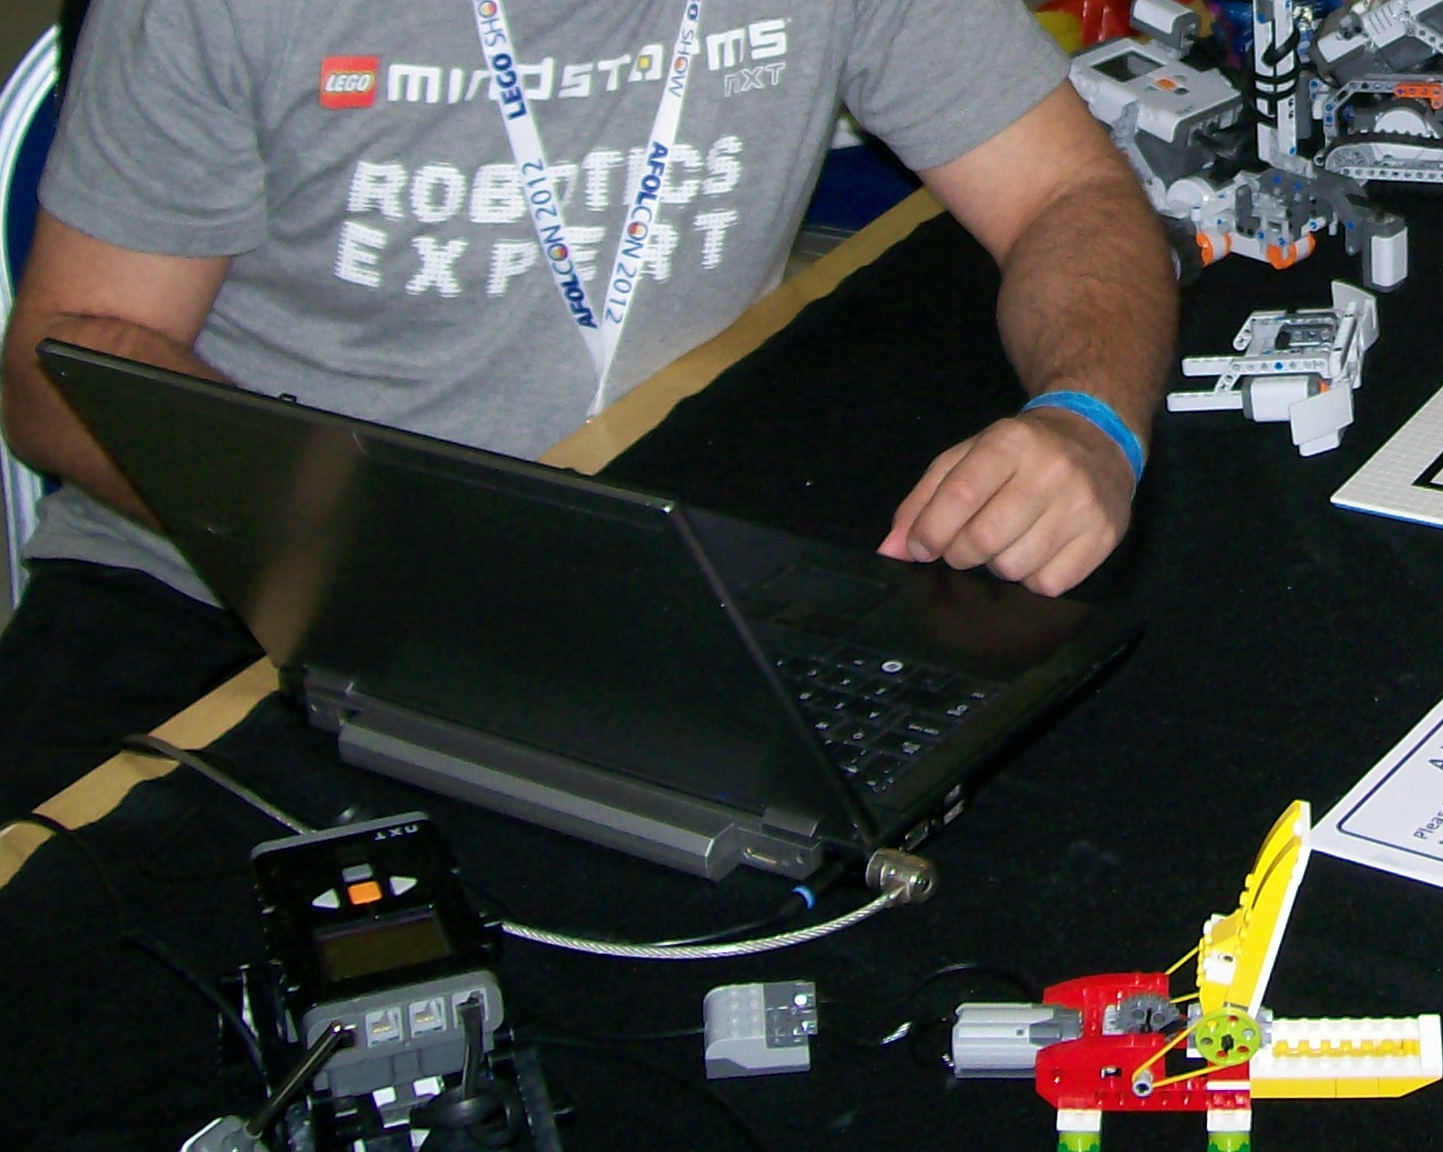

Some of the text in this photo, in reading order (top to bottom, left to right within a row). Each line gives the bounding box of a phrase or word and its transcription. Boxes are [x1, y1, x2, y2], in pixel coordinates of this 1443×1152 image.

[322, 71, 375, 95] LEGO
[386, 18, 788, 105] MINDSTOMS
[492, 52, 527, 120] LEGO
[668, 28, 695, 98] SHOW
[521, 158, 598, 329] AFOLCON 2012
[605, 141, 669, 324] AFOLCON 2012
